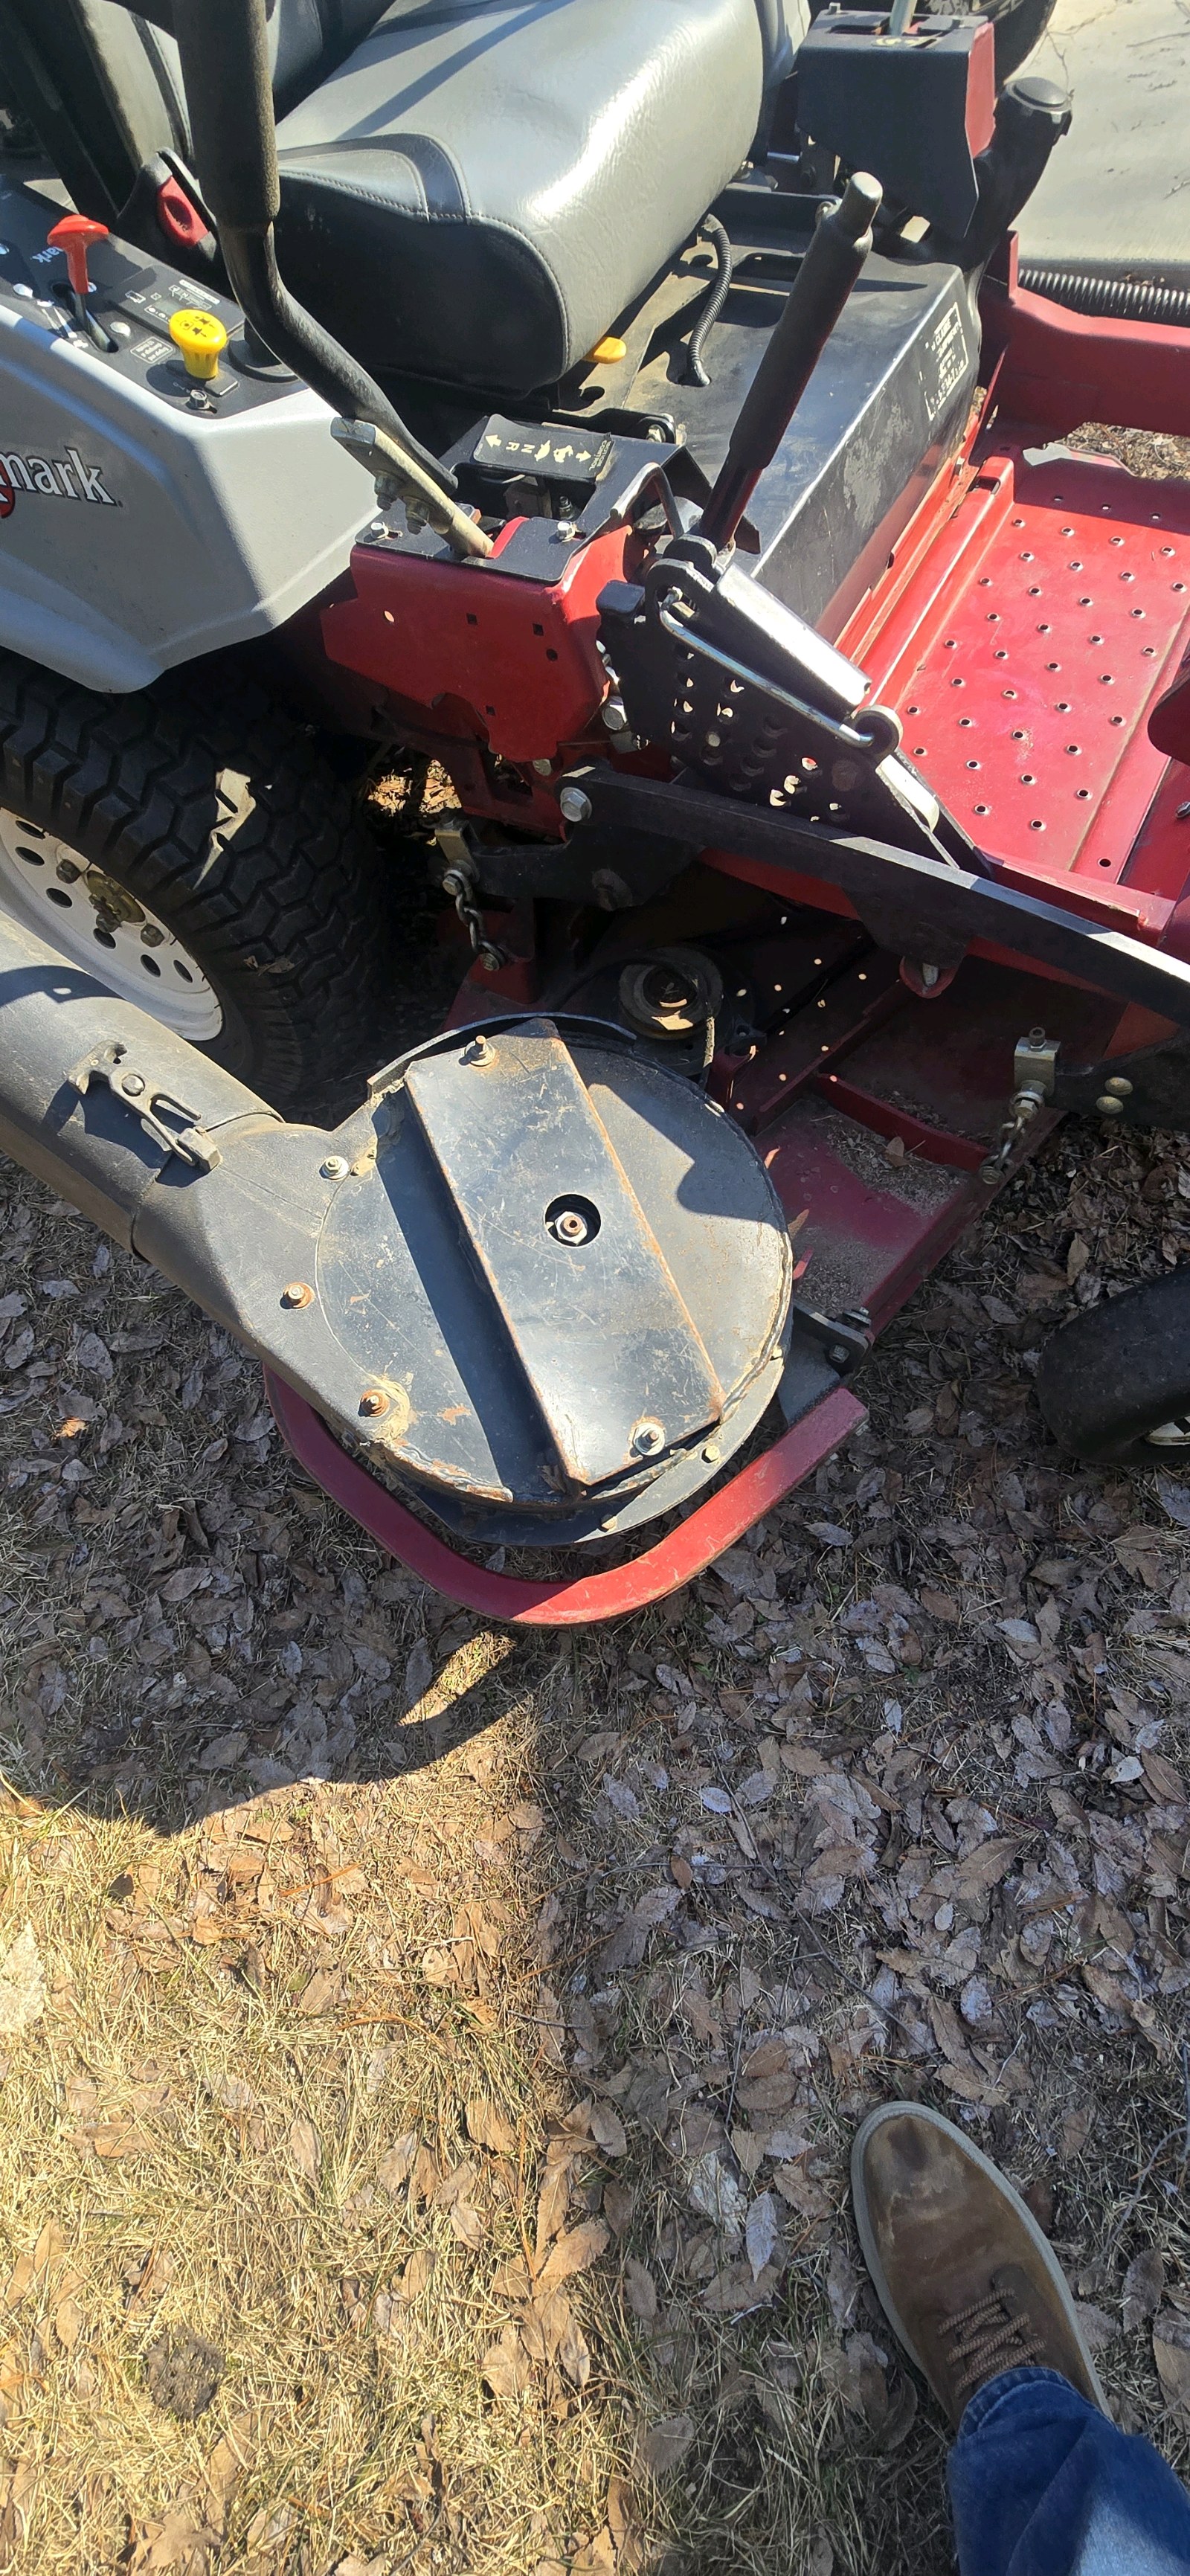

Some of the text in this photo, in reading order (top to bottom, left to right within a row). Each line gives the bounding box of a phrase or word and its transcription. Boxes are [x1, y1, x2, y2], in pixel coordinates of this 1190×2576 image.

[506, 441, 536, 453] R N
[588, 440, 607, 471] CONTROL
[0, 446, 117, 506] mark
